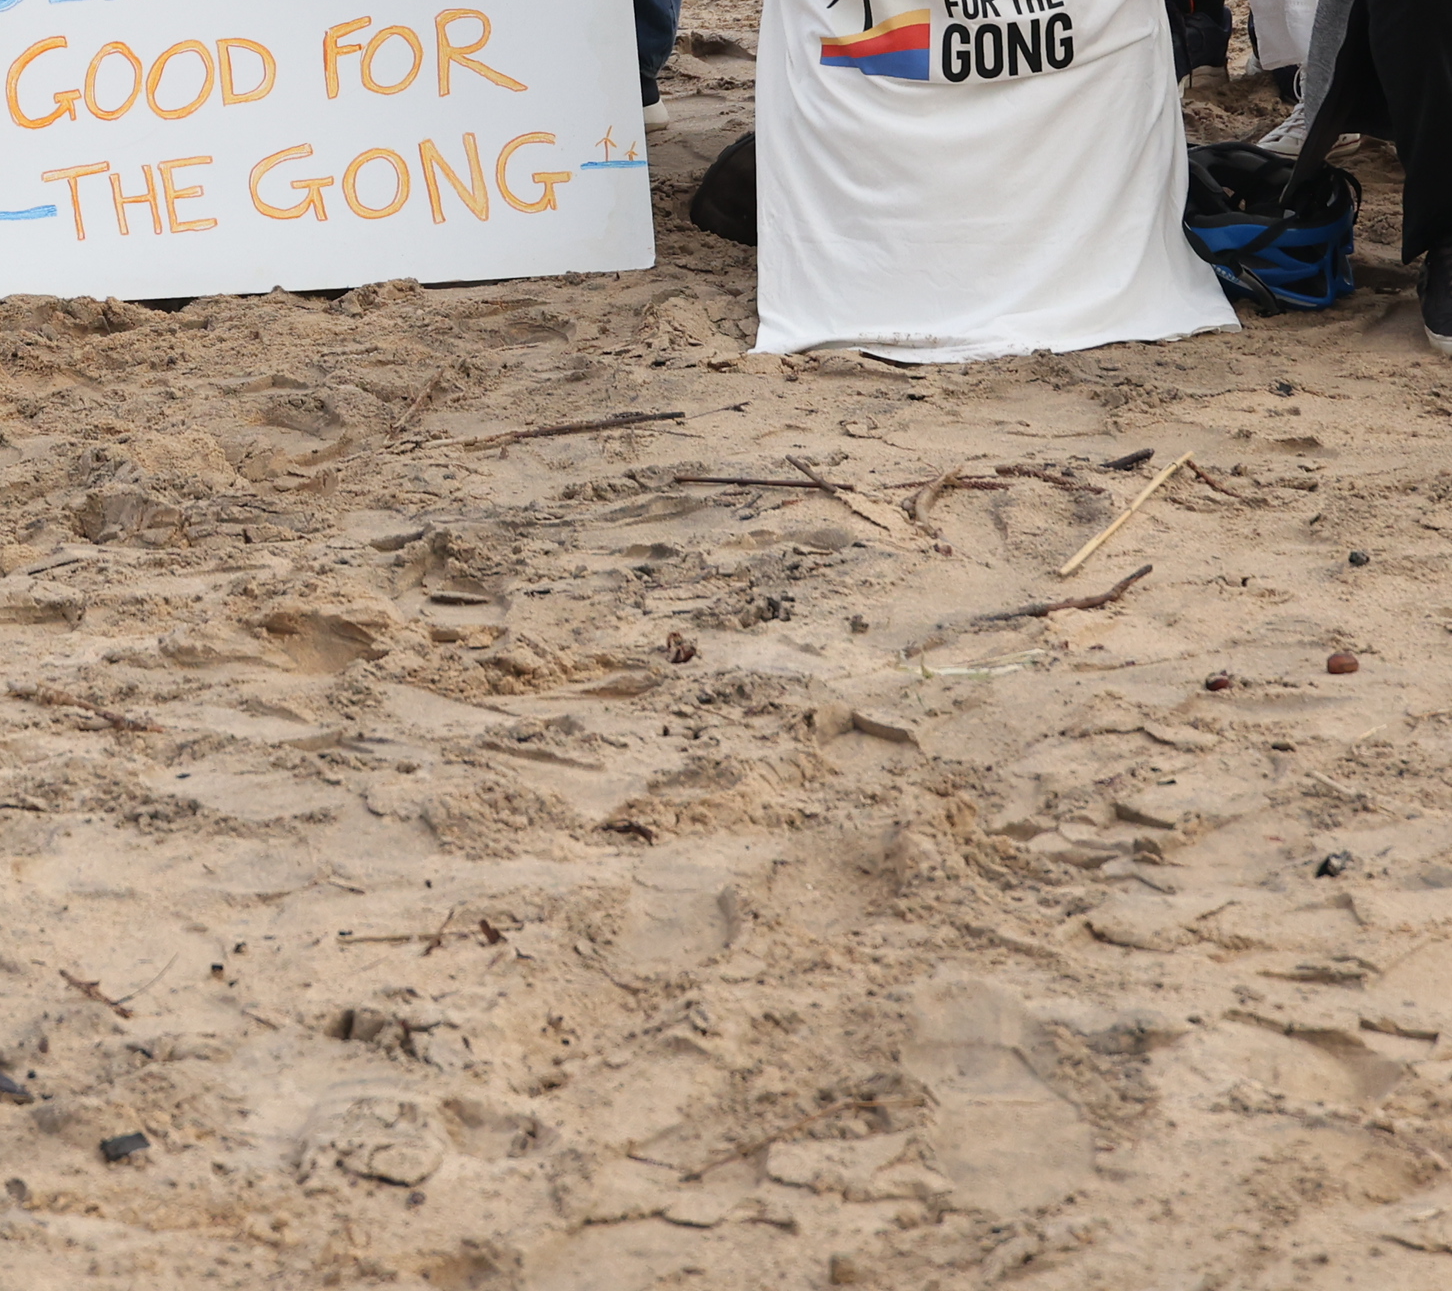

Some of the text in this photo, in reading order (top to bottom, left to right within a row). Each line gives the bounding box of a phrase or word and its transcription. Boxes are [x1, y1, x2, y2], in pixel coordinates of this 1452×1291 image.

[5, 8, 528, 130] GOOD FOR
[941, 12, 1075, 83] GONG
[41, 131, 572, 242] THE GONG
